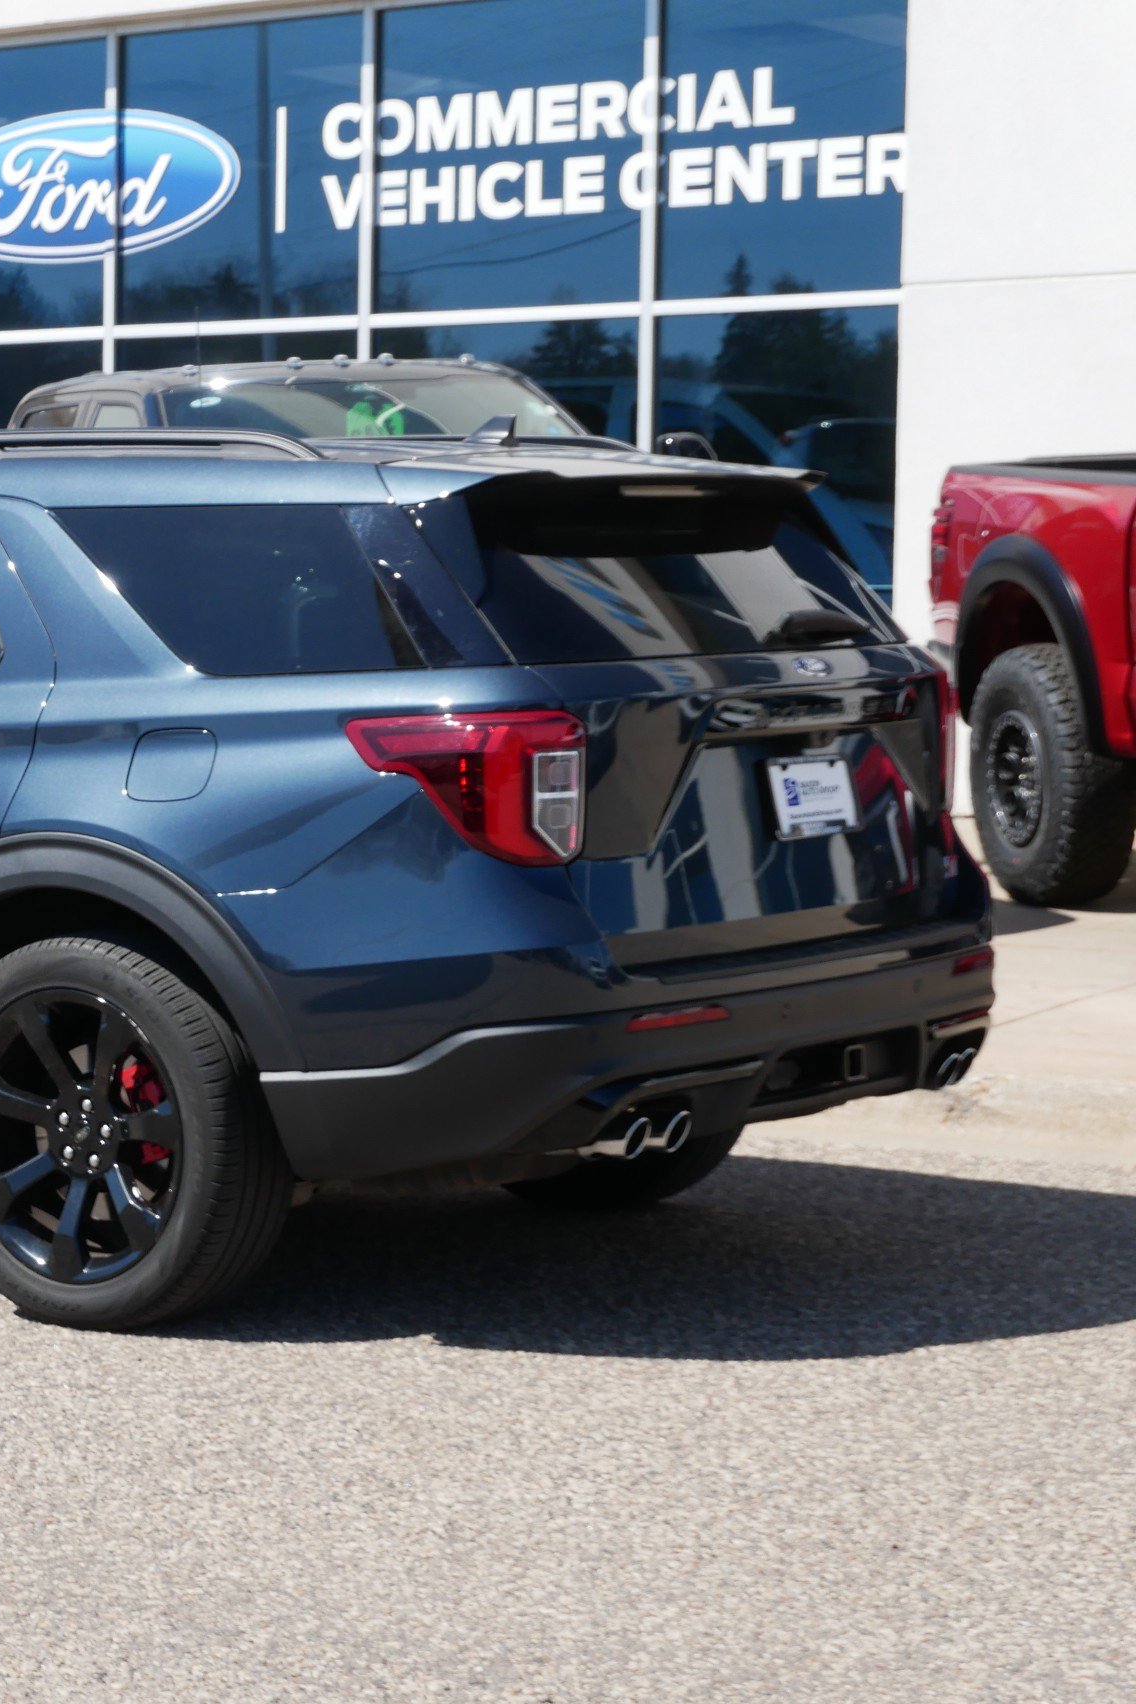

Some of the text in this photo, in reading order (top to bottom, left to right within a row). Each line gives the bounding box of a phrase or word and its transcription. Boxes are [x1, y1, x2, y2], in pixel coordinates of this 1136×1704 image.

[322, 66, 795, 160] COMMERCIAL
[321, 132, 907, 230] VEHICLE CENTER
